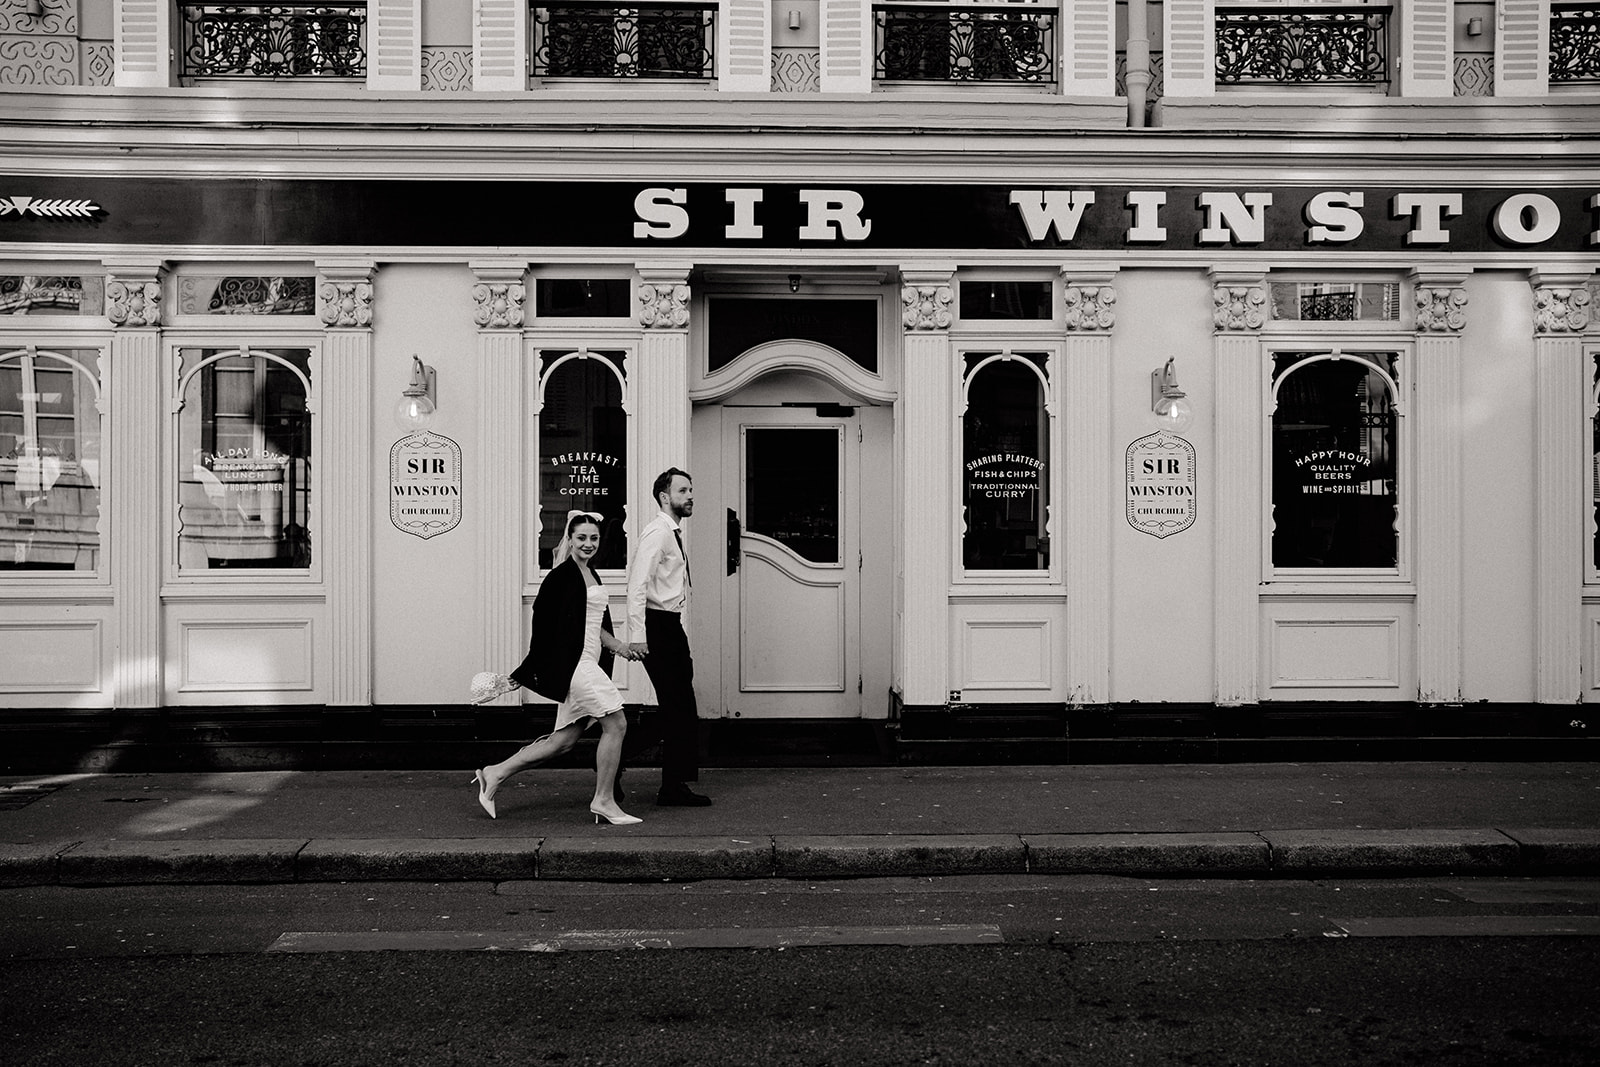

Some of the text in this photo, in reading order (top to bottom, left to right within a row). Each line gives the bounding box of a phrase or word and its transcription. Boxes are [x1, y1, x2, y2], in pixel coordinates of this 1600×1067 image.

[634, 188, 1600, 244] SIR WINSTO
[204, 447, 286, 465] ALL DAY LONG
[551, 452, 618, 466] BREAKFAST
[1295, 450, 1371, 467] HAPPY HOUR
[407, 458, 446, 474] SIR
[966, 454, 1046, 471] SHARING PLATTERS
[1143, 459, 1180, 474] SIR
[1310, 464, 1356, 472] QUALITY
[571, 465, 597, 474] TEA
[568, 474, 600, 483] TIME
[1315, 472, 1352, 480] BEERS
[393, 485, 459, 496] WINSTON
[559, 487, 609, 495] COFFEE
[985, 490, 1026, 498] CURRY
[1130, 485, 1194, 496] WINSTON
[1302, 485, 1323, 494] WINE
